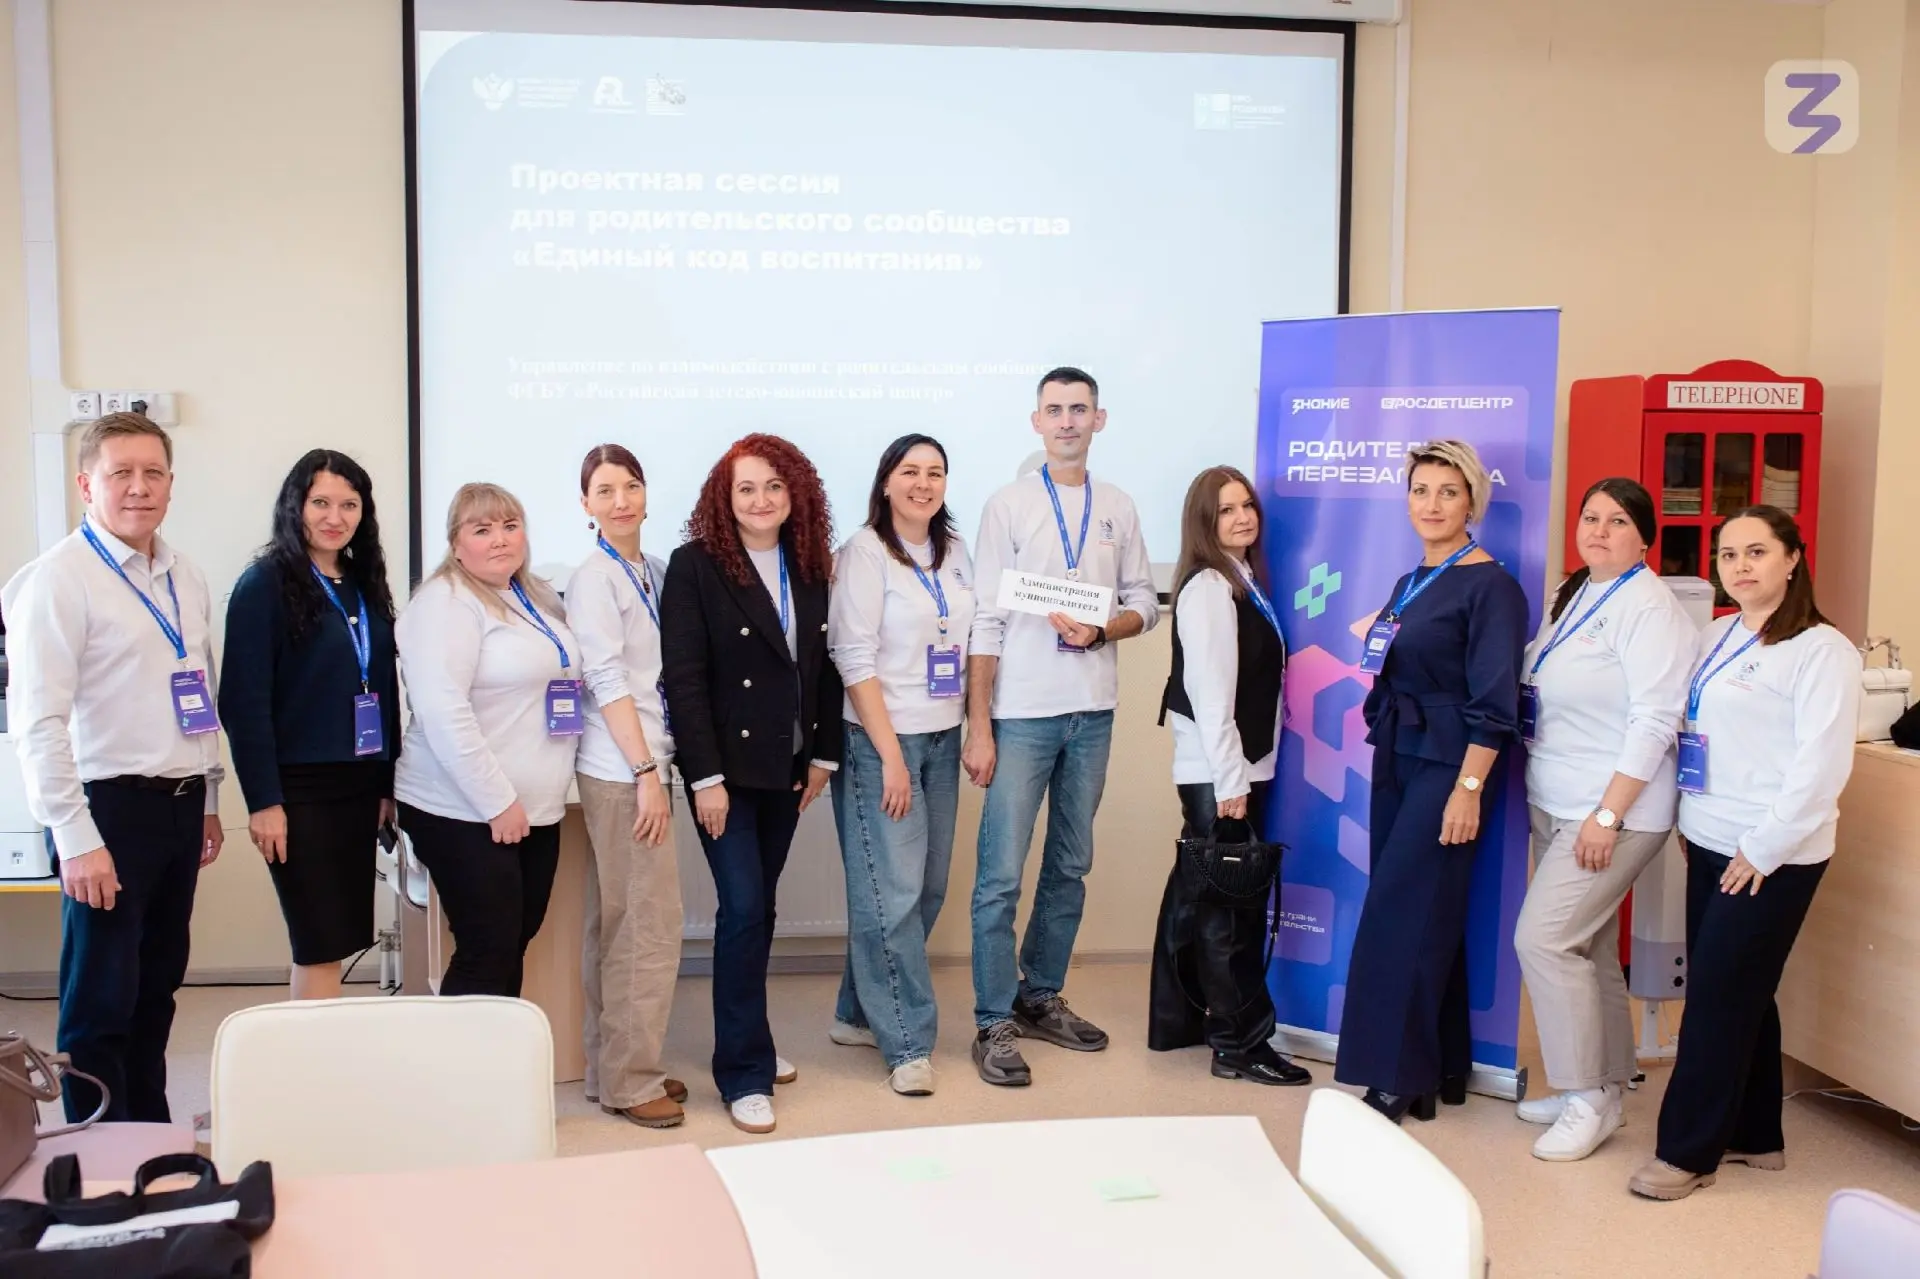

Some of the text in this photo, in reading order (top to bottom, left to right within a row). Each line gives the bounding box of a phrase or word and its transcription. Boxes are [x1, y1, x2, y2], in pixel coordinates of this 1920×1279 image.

[509, 162, 841, 196] Проектная сессия
[509, 207, 1072, 239] для родительского сообщества
[512, 241, 983, 274] «Единый код воспитания»
[1395, 397, 1514, 410] РОСДЕТЦЕНТР
[1674, 385, 1799, 405] TELEPHONE
[1019, 576, 1101, 599] Администрация
[1014, 590, 1100, 612] муниципалитета
